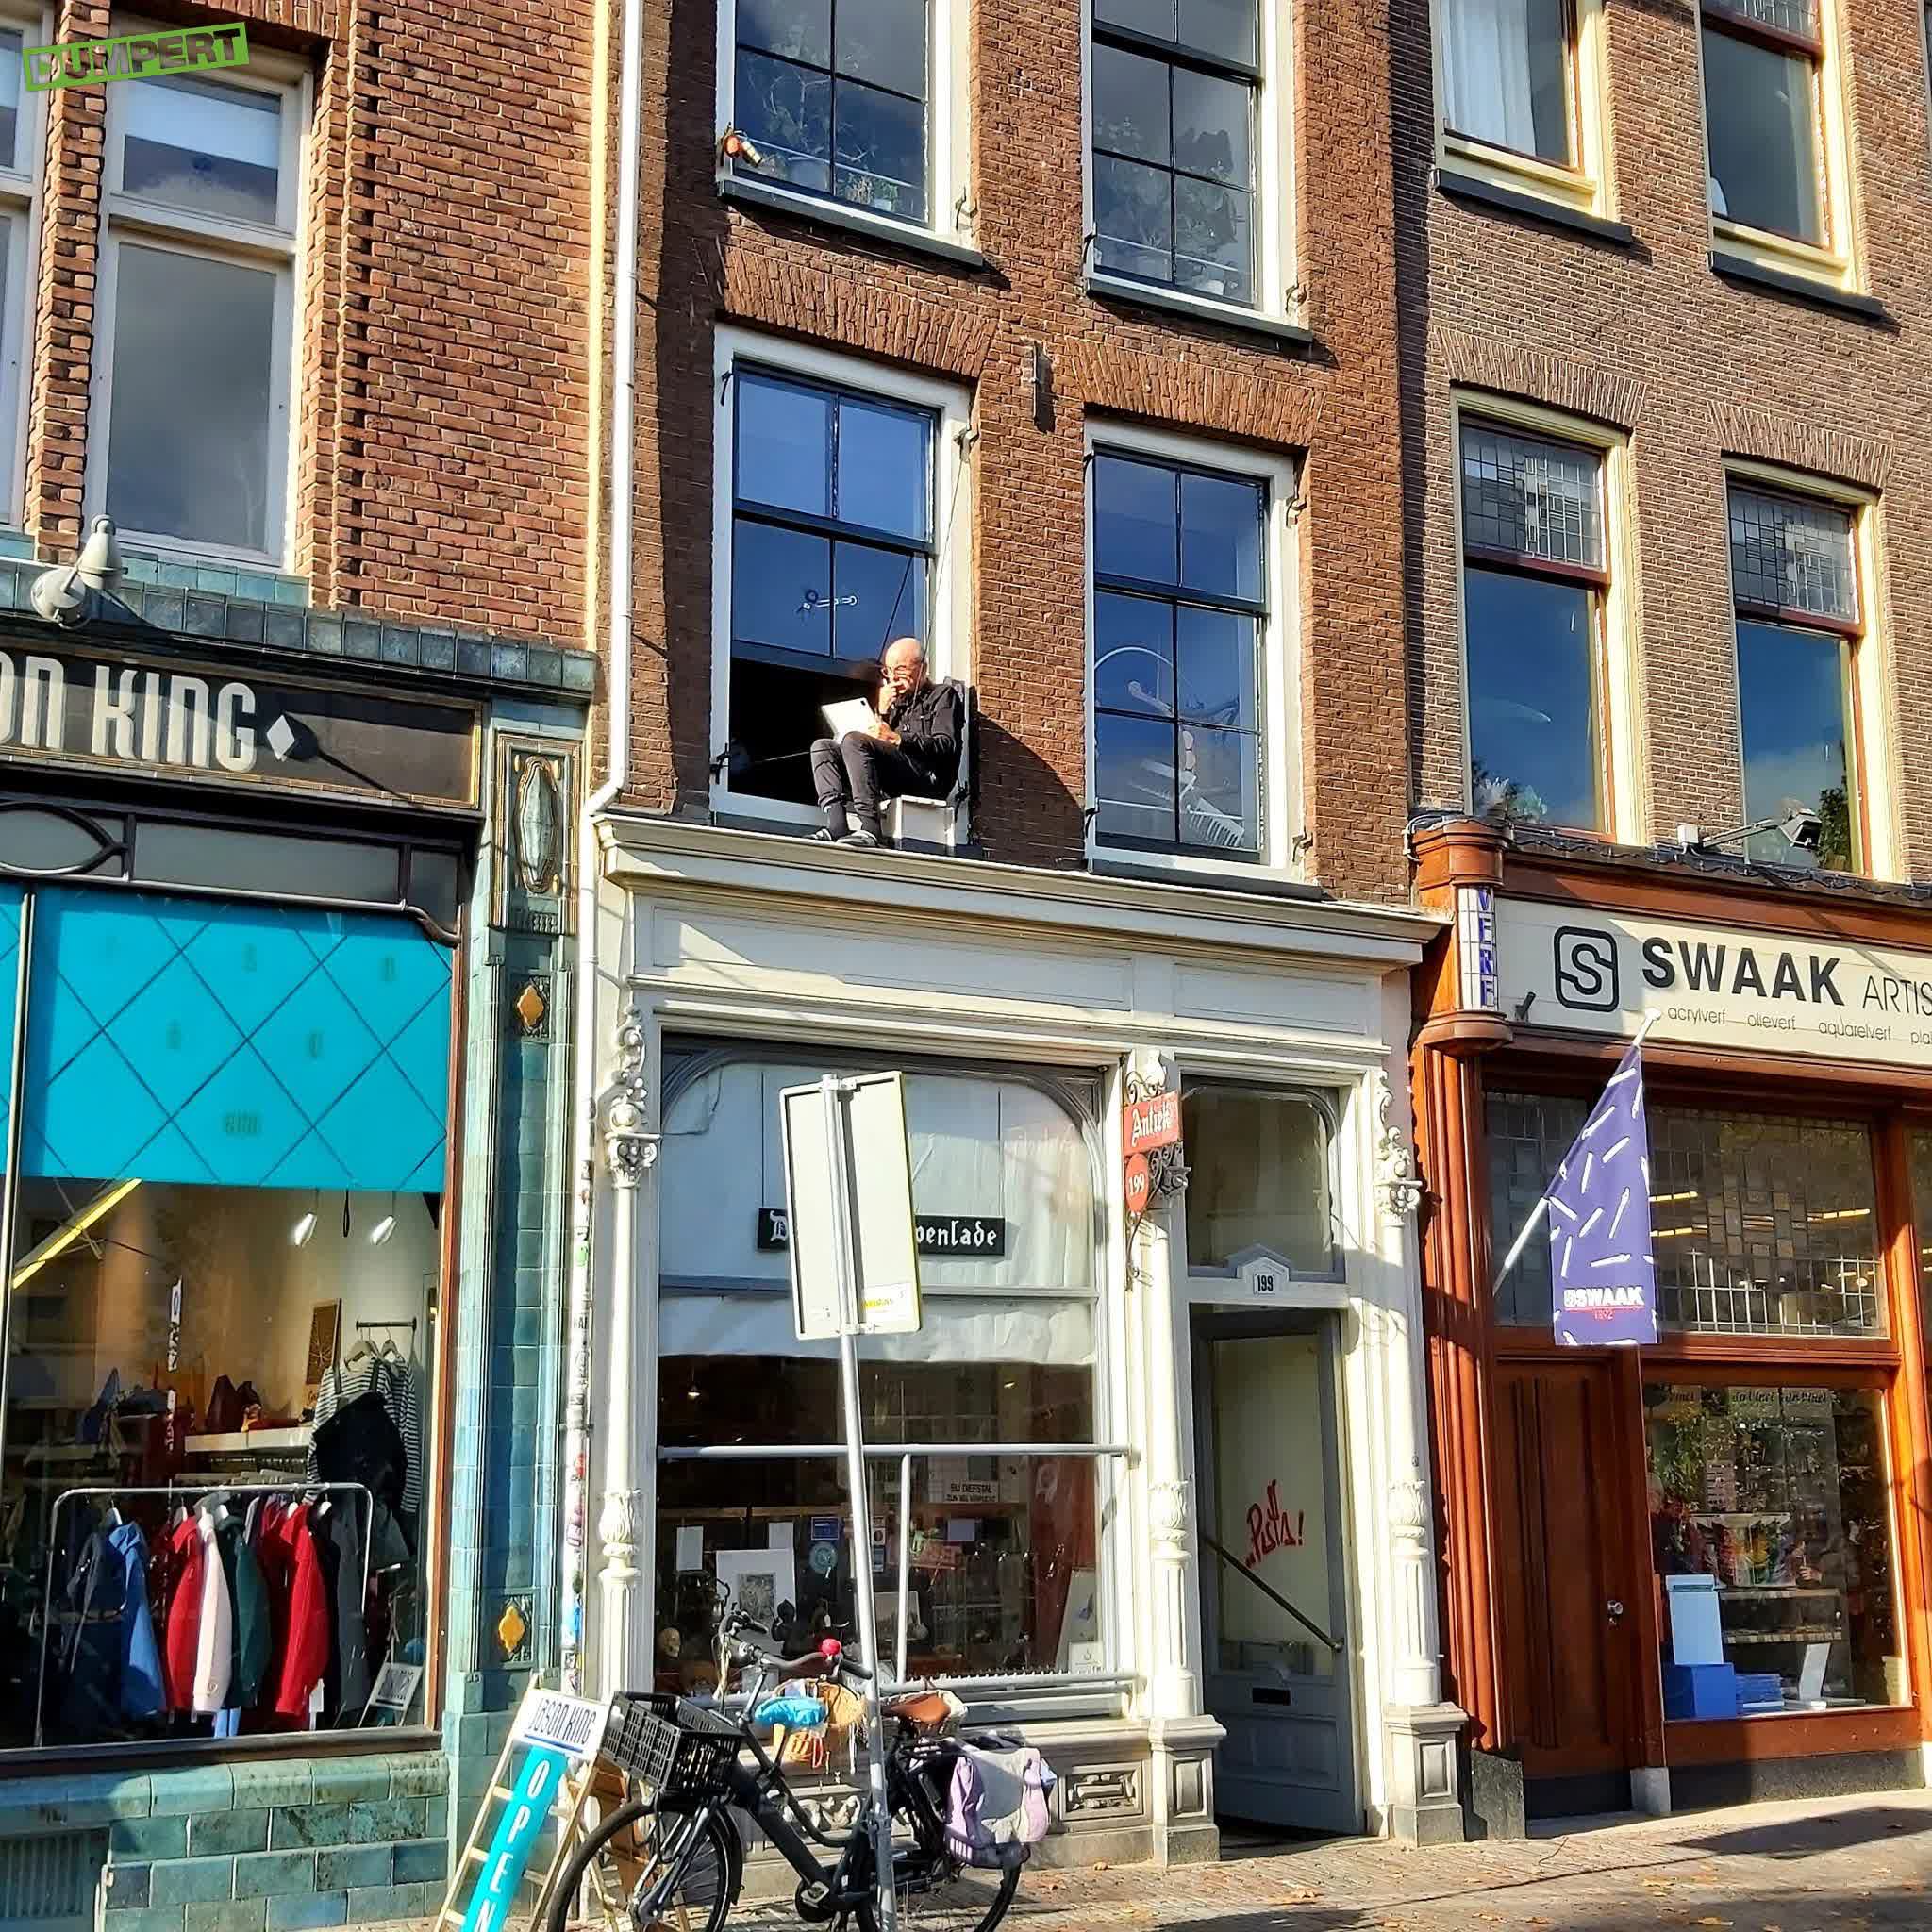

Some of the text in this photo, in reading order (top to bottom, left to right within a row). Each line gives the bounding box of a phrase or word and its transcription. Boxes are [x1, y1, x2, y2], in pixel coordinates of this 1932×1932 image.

[92, 665, 257, 774] KING
[1641, 937, 1845, 1007] SWAAK
[1910, 1028, 1932, 1046] pla
[1128, 1173, 1145, 1196] 199
[1257, 1274, 1274, 1292] 199
[562, 1706, 597, 1745] KING
[474, 1759, 551, 1932] OPEN
